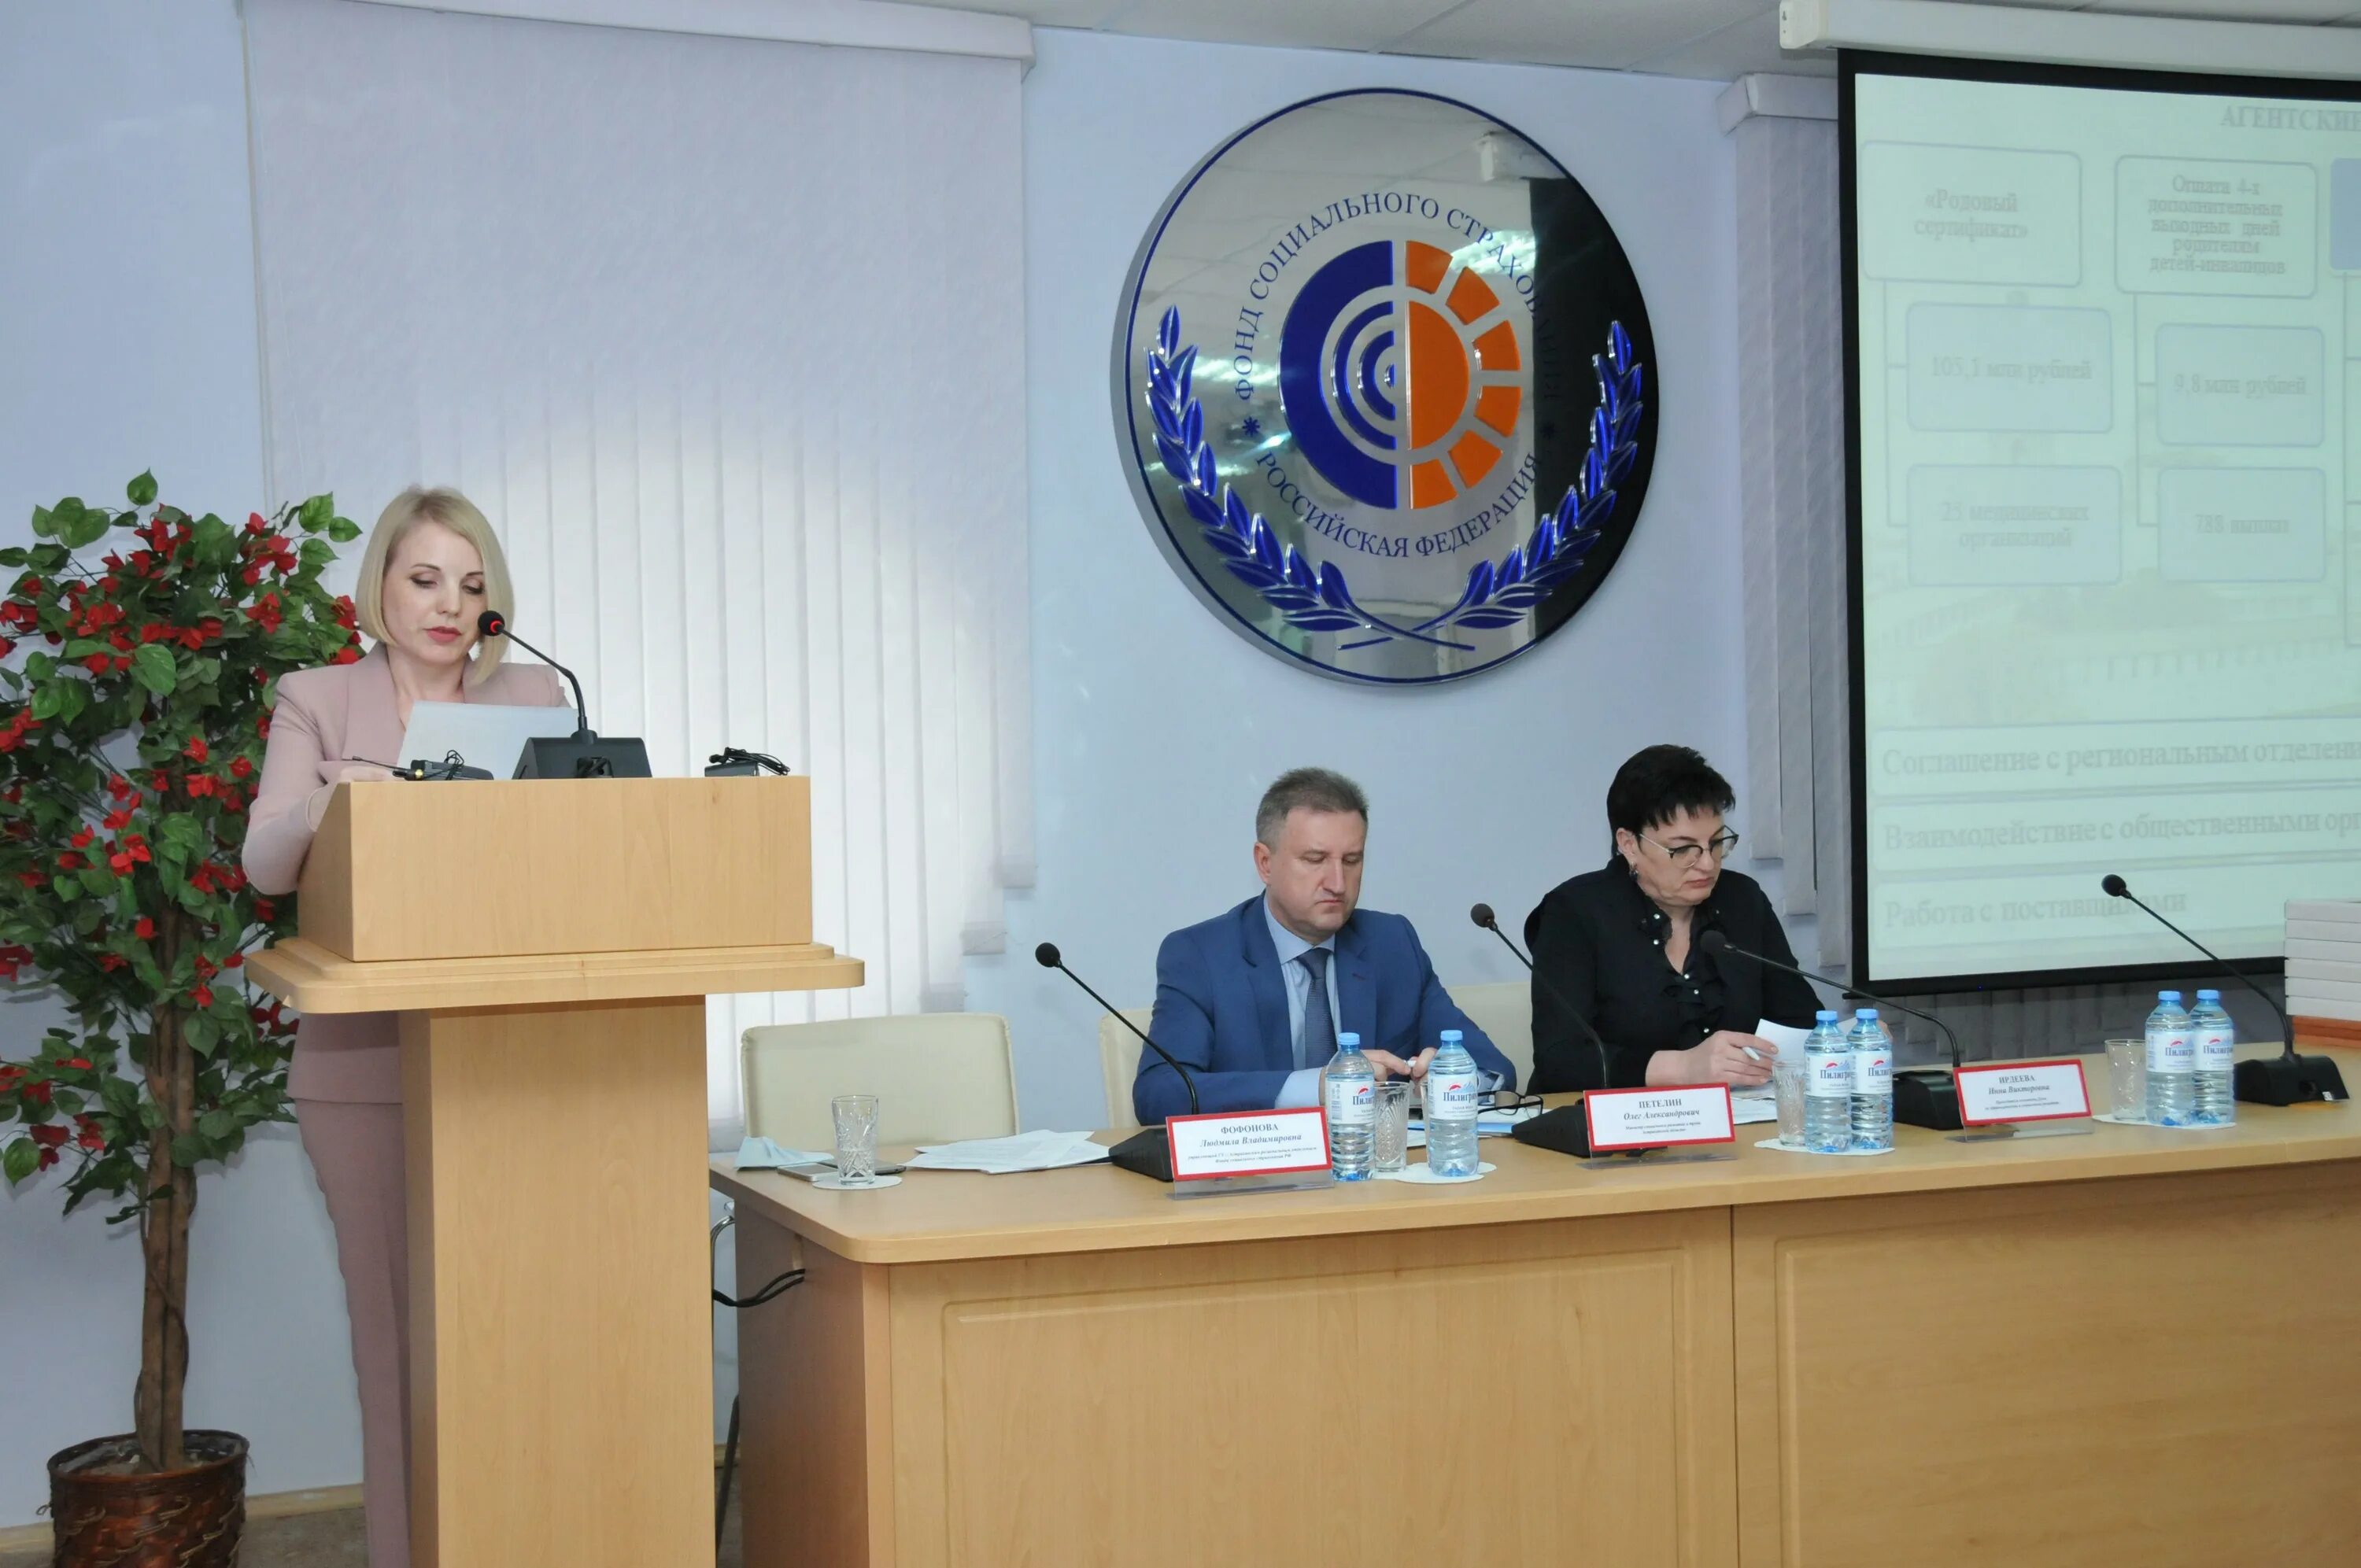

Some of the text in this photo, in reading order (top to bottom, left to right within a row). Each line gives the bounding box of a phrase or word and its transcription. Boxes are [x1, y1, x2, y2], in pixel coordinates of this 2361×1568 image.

[1924, 188, 2018, 212] «Родовый
[1233, 305, 1264, 400] ФОНД
[1249, 191, 1439, 301] СОЦИАЛЬНОГО
[1256, 452, 1539, 558] РОССИЙСКАЯ ФЕДЕРАЦИЯ
[1883, 748, 2041, 775] Соглашение
[2047, 751, 2060, 769] с
[2065, 744, 2249, 777] региональным
[1883, 819, 2097, 850] Взаимодействие
[2101, 822, 2114, 840] с
[2119, 813, 2320, 840] общественными
[1884, 899, 1975, 928] Работа
[1979, 904, 1993, 924] с
[1999, 1075, 2035, 1083] ИРДЕЕВА
[2008, 1085, 2050, 1094] Викторовна
[1639, 1098, 1682, 1109] ПЕТЕЛИН
[1643, 1109, 1700, 1120] Александрович
[1221, 1123, 1279, 1134] ФОФОНОВА
[1199, 1134, 1302, 1148] Людмила Владимировна
